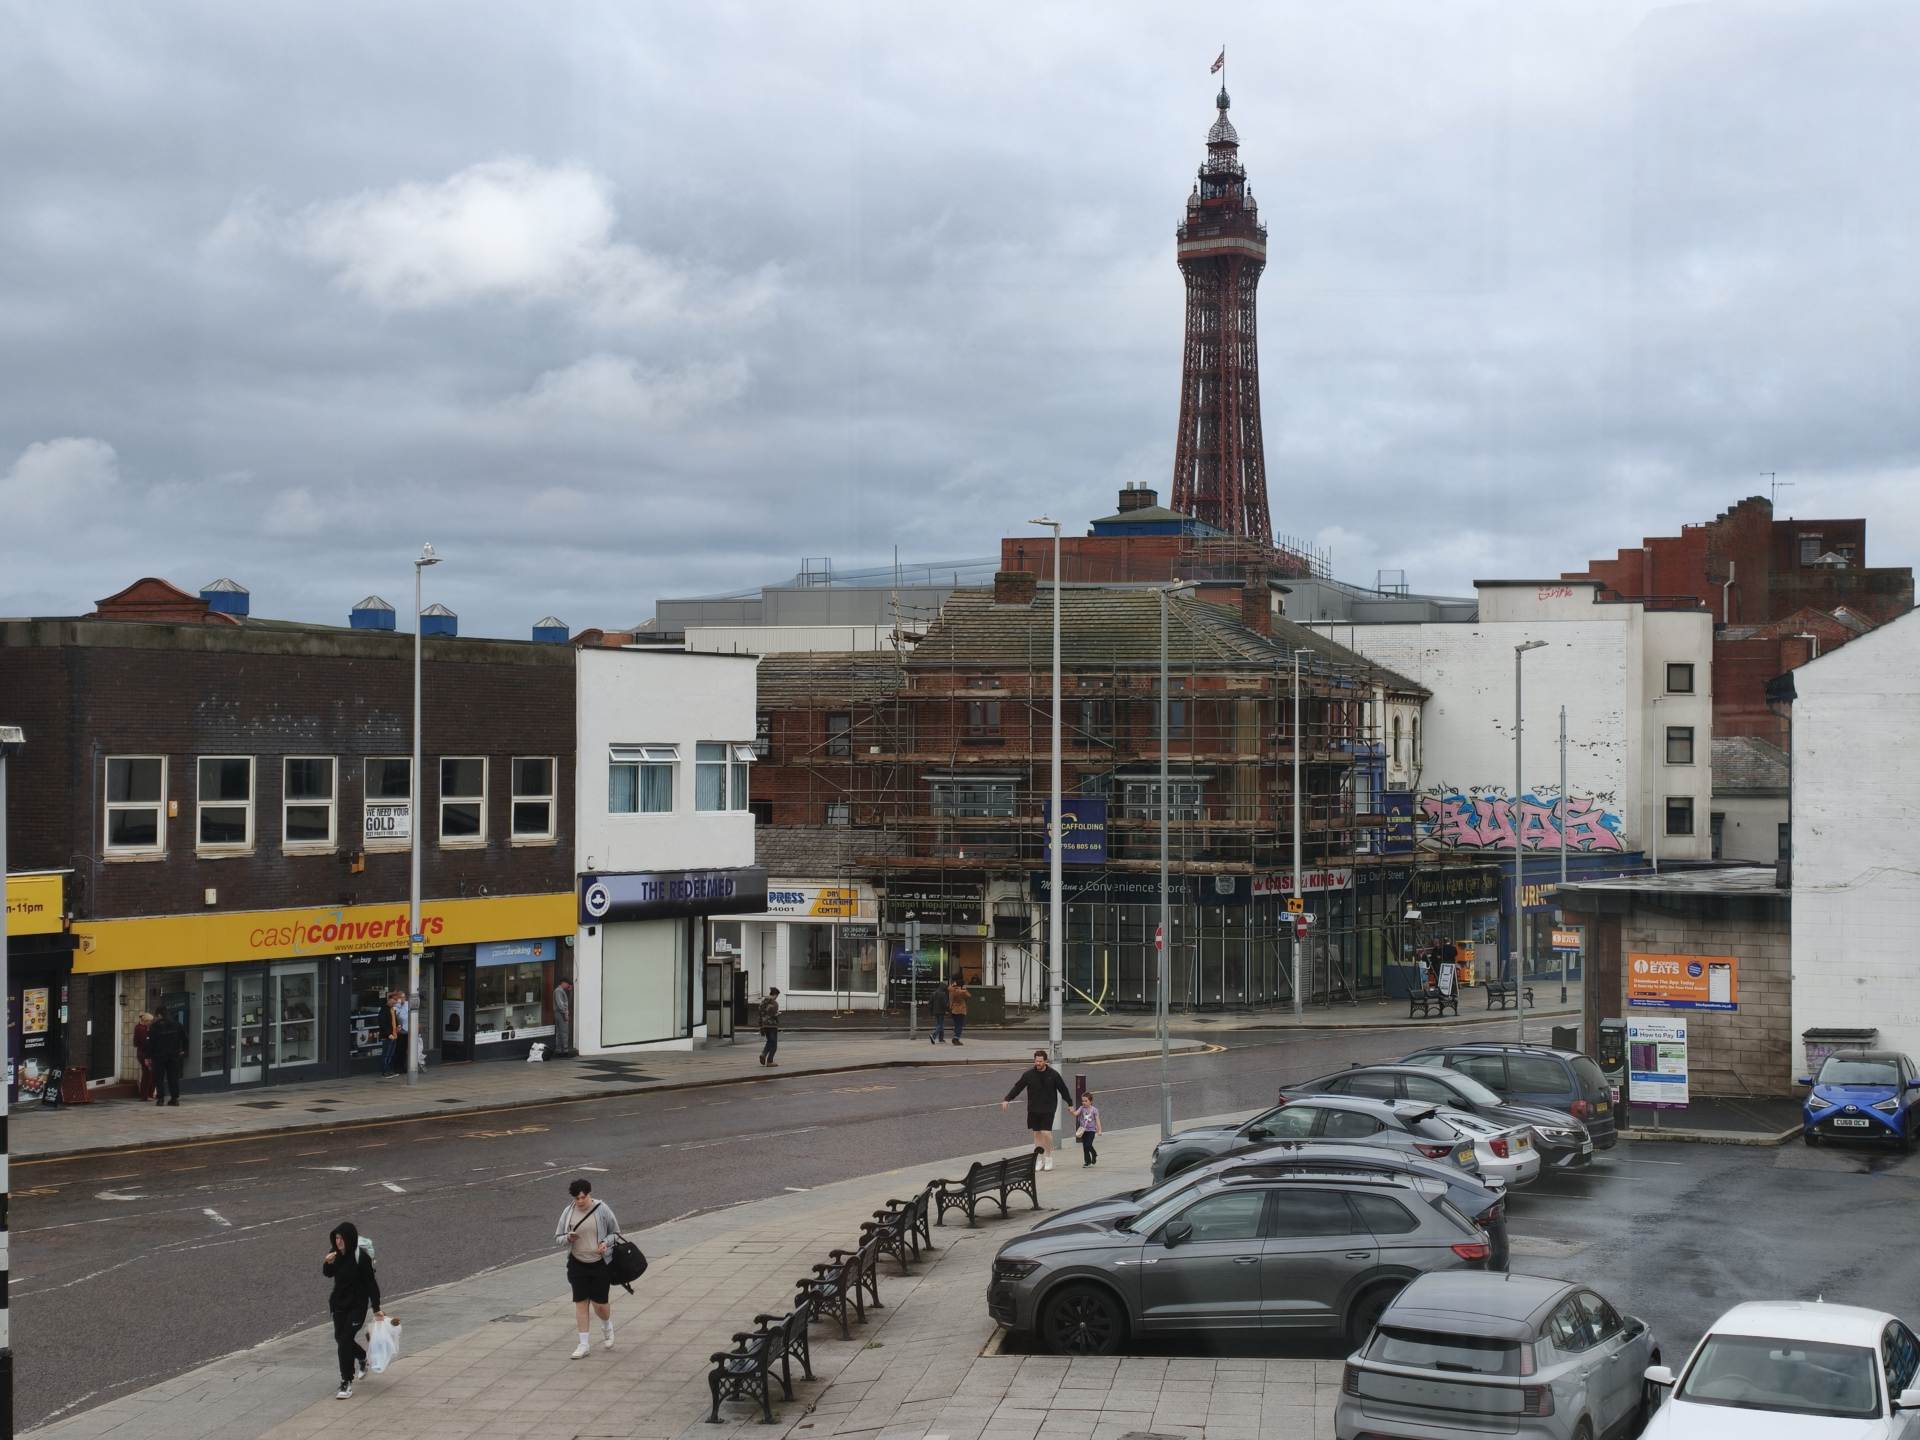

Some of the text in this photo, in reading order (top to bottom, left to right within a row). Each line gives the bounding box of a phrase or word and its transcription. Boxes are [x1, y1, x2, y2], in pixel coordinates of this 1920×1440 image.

[367, 807, 409, 816] WE NEED YOUR
[366, 817, 394, 831] GOLD
[1061, 823, 1104, 831] CAFFOLDING
[1309, 873, 1335, 888] KING
[641, 878, 734, 901] THE REDEEMED
[1086, 881, 1155, 893] Convenience
[1157, 882, 1192, 894] Sores
[768, 892, 805, 905] PRESS
[1650, 965, 1680, 975] EATS
[1639, 1031, 1654, 1039] How
[1654, 1031, 1662, 1039] to
